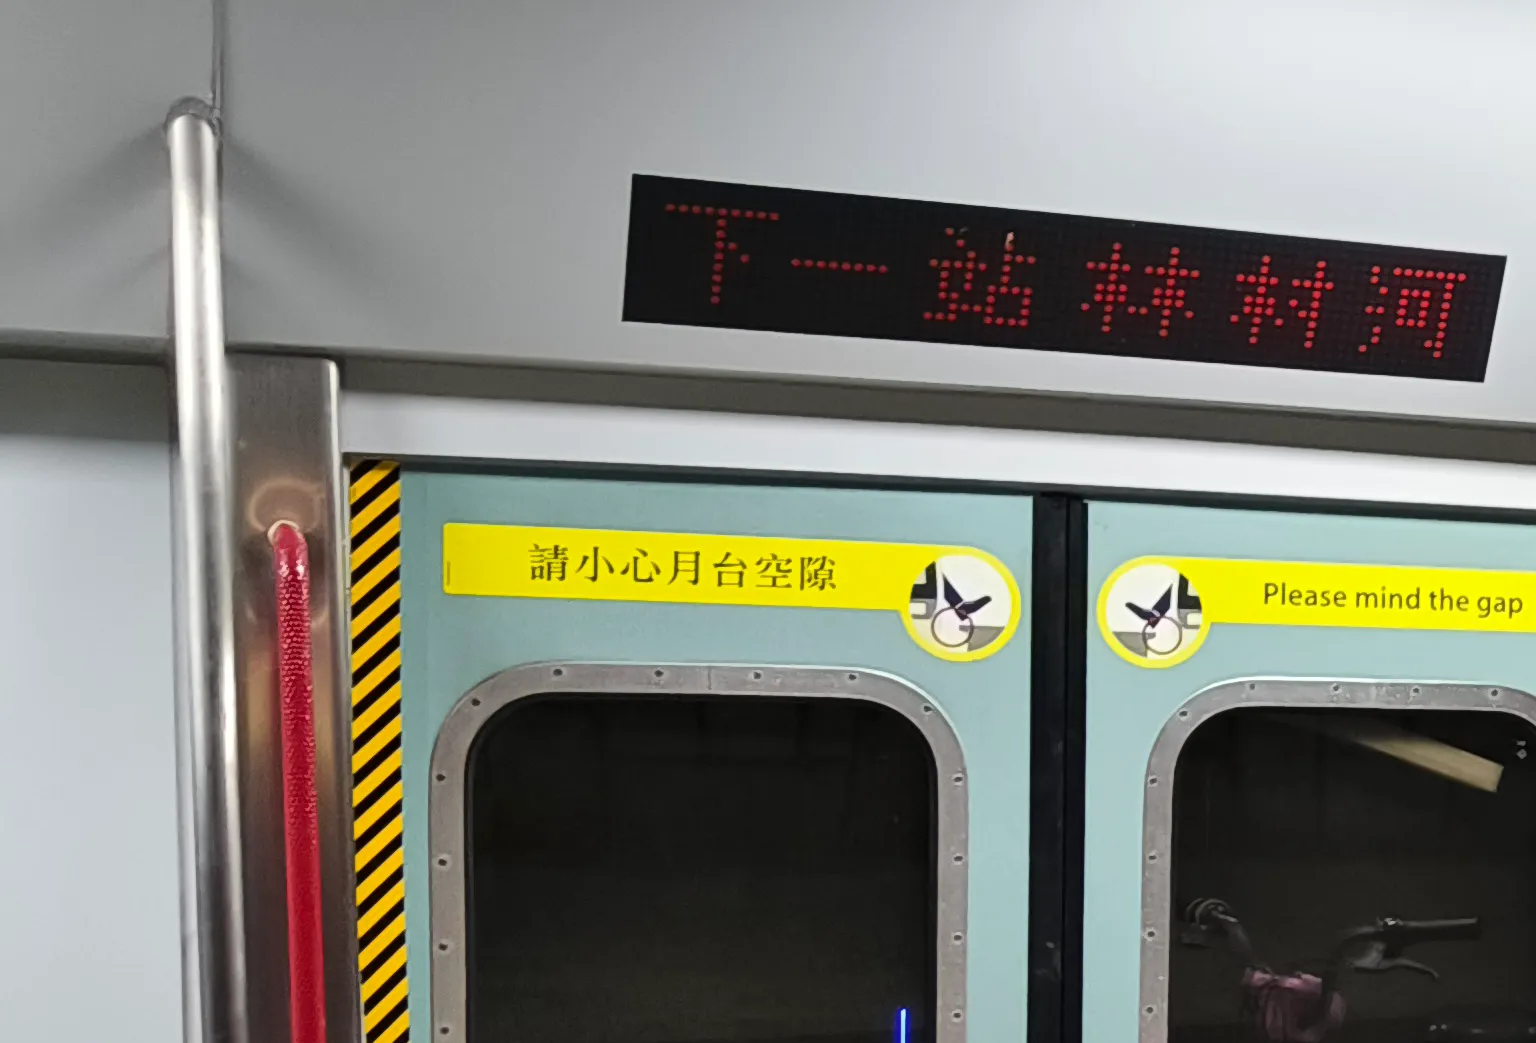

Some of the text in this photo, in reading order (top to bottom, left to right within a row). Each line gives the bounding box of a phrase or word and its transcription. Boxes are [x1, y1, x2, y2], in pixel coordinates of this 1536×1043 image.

[664, 201, 1469, 358] 下一站林村河
[528, 543, 838, 591] 請小心月台空隙
[1264, 582, 1524, 619] Please mind the gap
